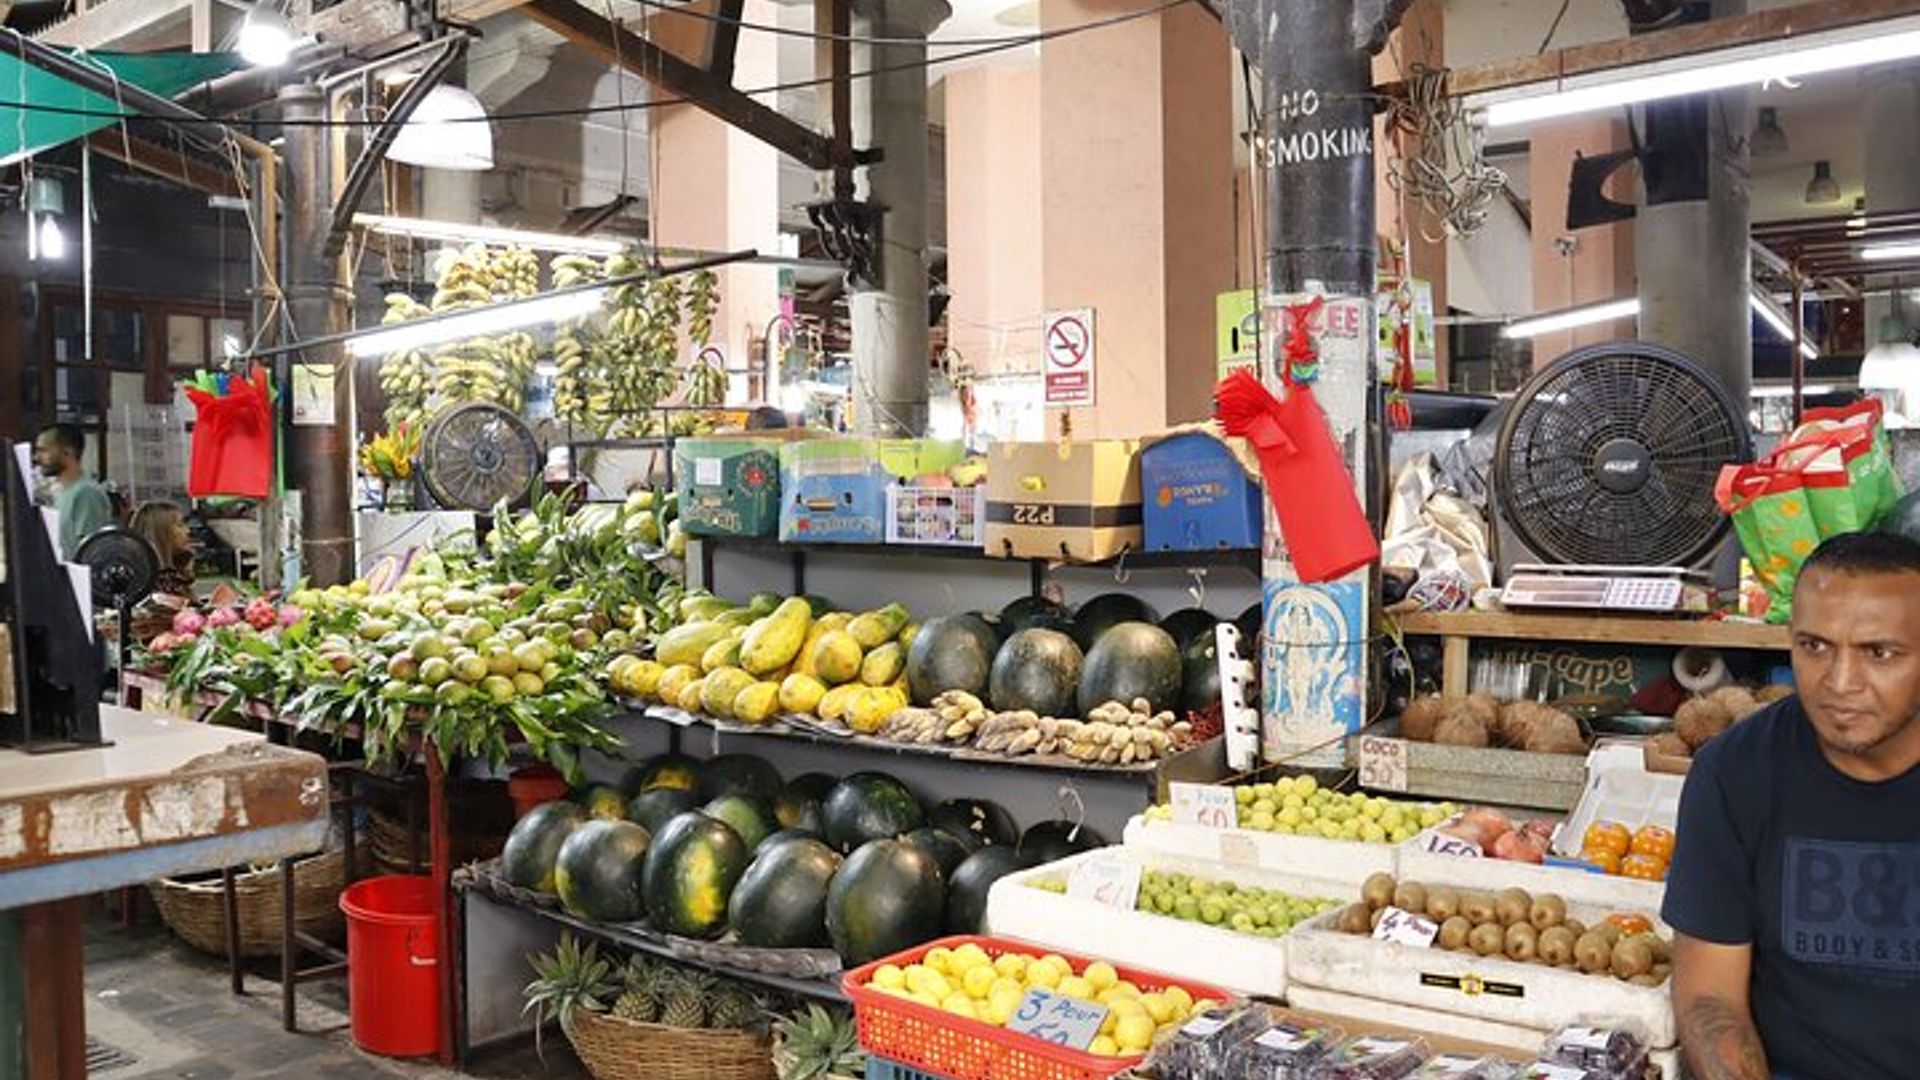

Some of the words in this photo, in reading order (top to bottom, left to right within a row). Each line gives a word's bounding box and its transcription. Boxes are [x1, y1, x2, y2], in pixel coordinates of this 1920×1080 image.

[1281, 88, 1319, 120] NO
[1012, 504, 1055, 525] P22
[1362, 738, 1399, 757] COCO
[1797, 848, 1920, 926] B&
[1795, 931, 1864, 957] BODY
[1874, 938, 1889, 959] &
[1017, 990, 1050, 1021] 3
[1051, 999, 1100, 1020] Pour
